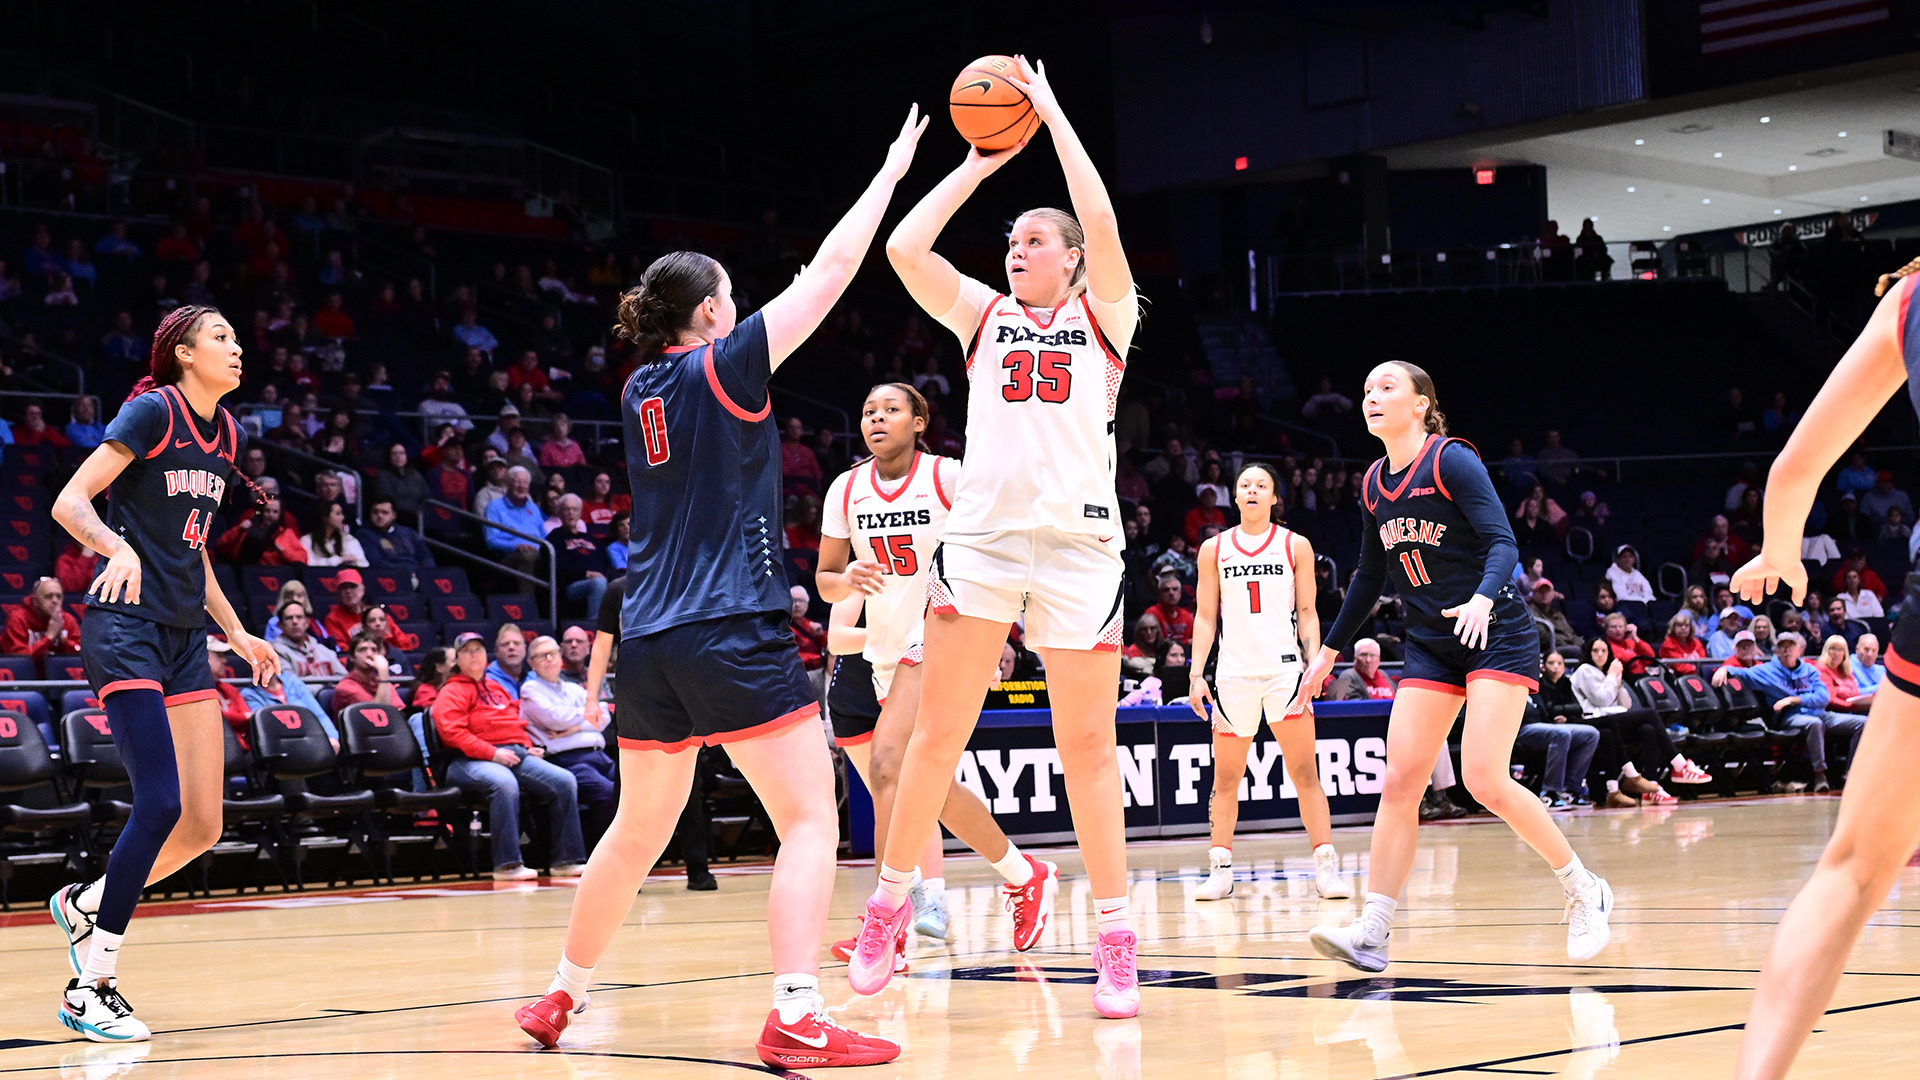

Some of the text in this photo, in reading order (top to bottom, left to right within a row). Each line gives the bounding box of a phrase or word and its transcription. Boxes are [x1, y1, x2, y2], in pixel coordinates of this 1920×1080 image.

[996, 325, 1087, 347] FLYERS
[1002, 350, 1072, 404] 35
[639, 396, 670, 466] 0
[164, 469, 225, 504] DUQUES
[856, 509, 931, 530] FLYERS
[1379, 517, 1447, 551] QUESNE
[869, 534, 918, 576] 15
[1223, 564, 1284, 579] FLYERS
[1399, 549, 1431, 587] 11
[1246, 581, 1261, 614] 1
[990, 680, 1047, 692] FORMATION
[1008, 693, 1035, 704] RADIO
[954, 744, 1156, 814] AYTN
[1168, 737, 1387, 805] FYRS
